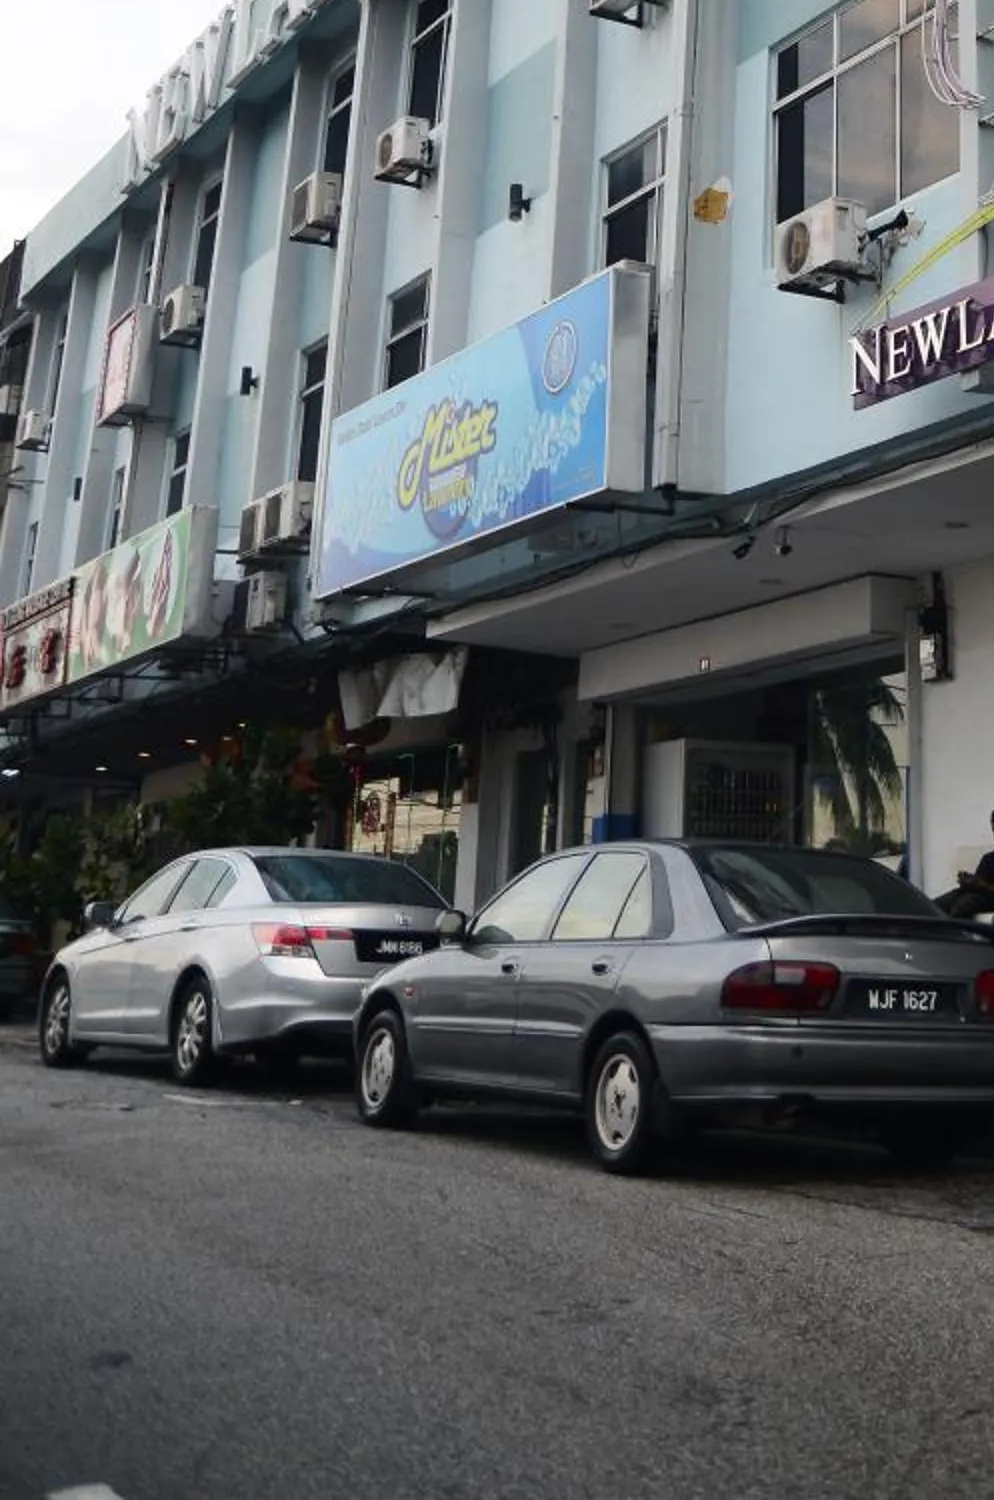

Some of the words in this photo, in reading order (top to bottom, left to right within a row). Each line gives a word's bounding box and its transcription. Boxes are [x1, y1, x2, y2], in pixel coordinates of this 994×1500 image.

[398, 400, 498, 509] Mister
[868, 988, 898, 1010] WJF
[903, 990, 937, 1011] 1627
